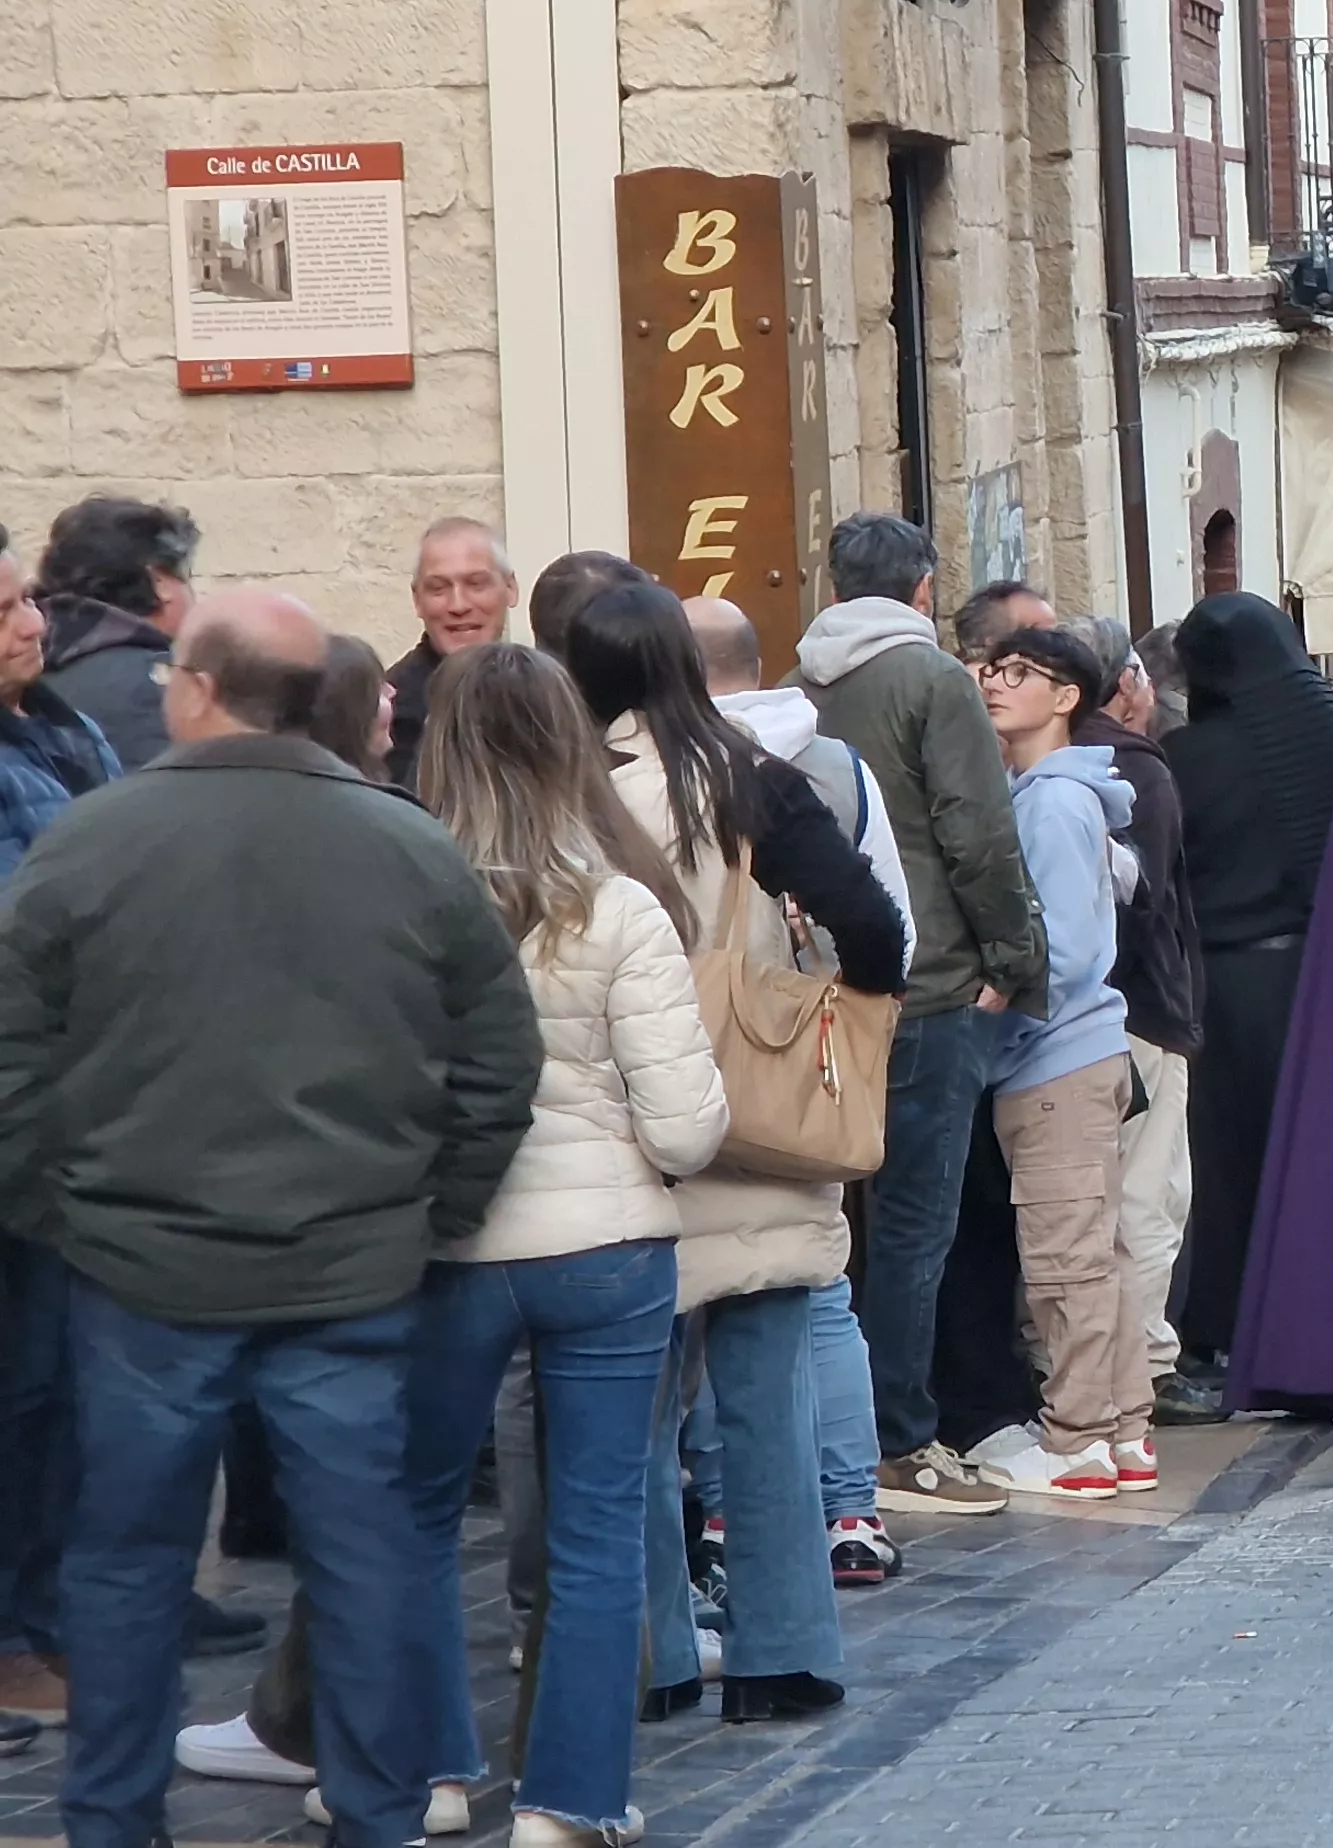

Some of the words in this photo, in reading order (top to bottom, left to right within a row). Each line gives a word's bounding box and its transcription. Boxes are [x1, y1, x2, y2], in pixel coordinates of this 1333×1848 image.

[207, 157, 246, 175] Calle
[251, 156, 272, 174] de
[275, 152, 361, 173] CASTILLA
[663, 209, 744, 429] BAR
[793, 207, 818, 423] BAR
